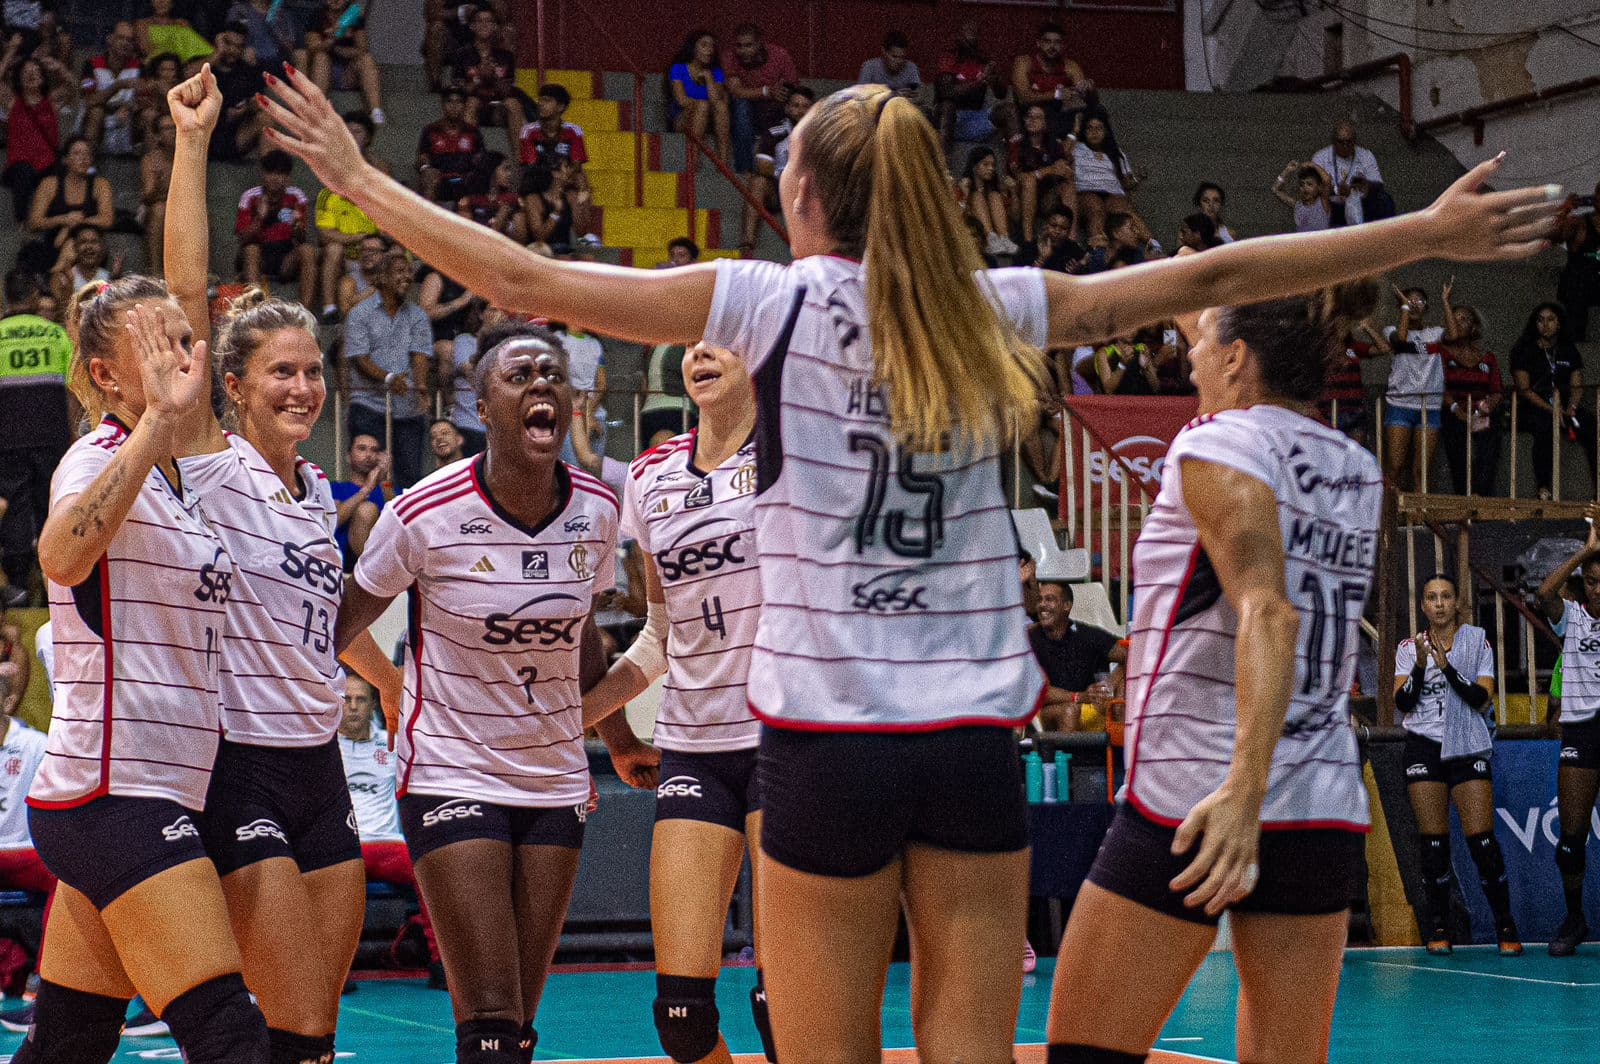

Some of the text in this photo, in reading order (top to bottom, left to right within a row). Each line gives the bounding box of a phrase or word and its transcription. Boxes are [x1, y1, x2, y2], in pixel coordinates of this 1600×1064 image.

[9, 347, 51, 369] 031
[301, 599, 329, 654] 13
[701, 595, 727, 641] 4
